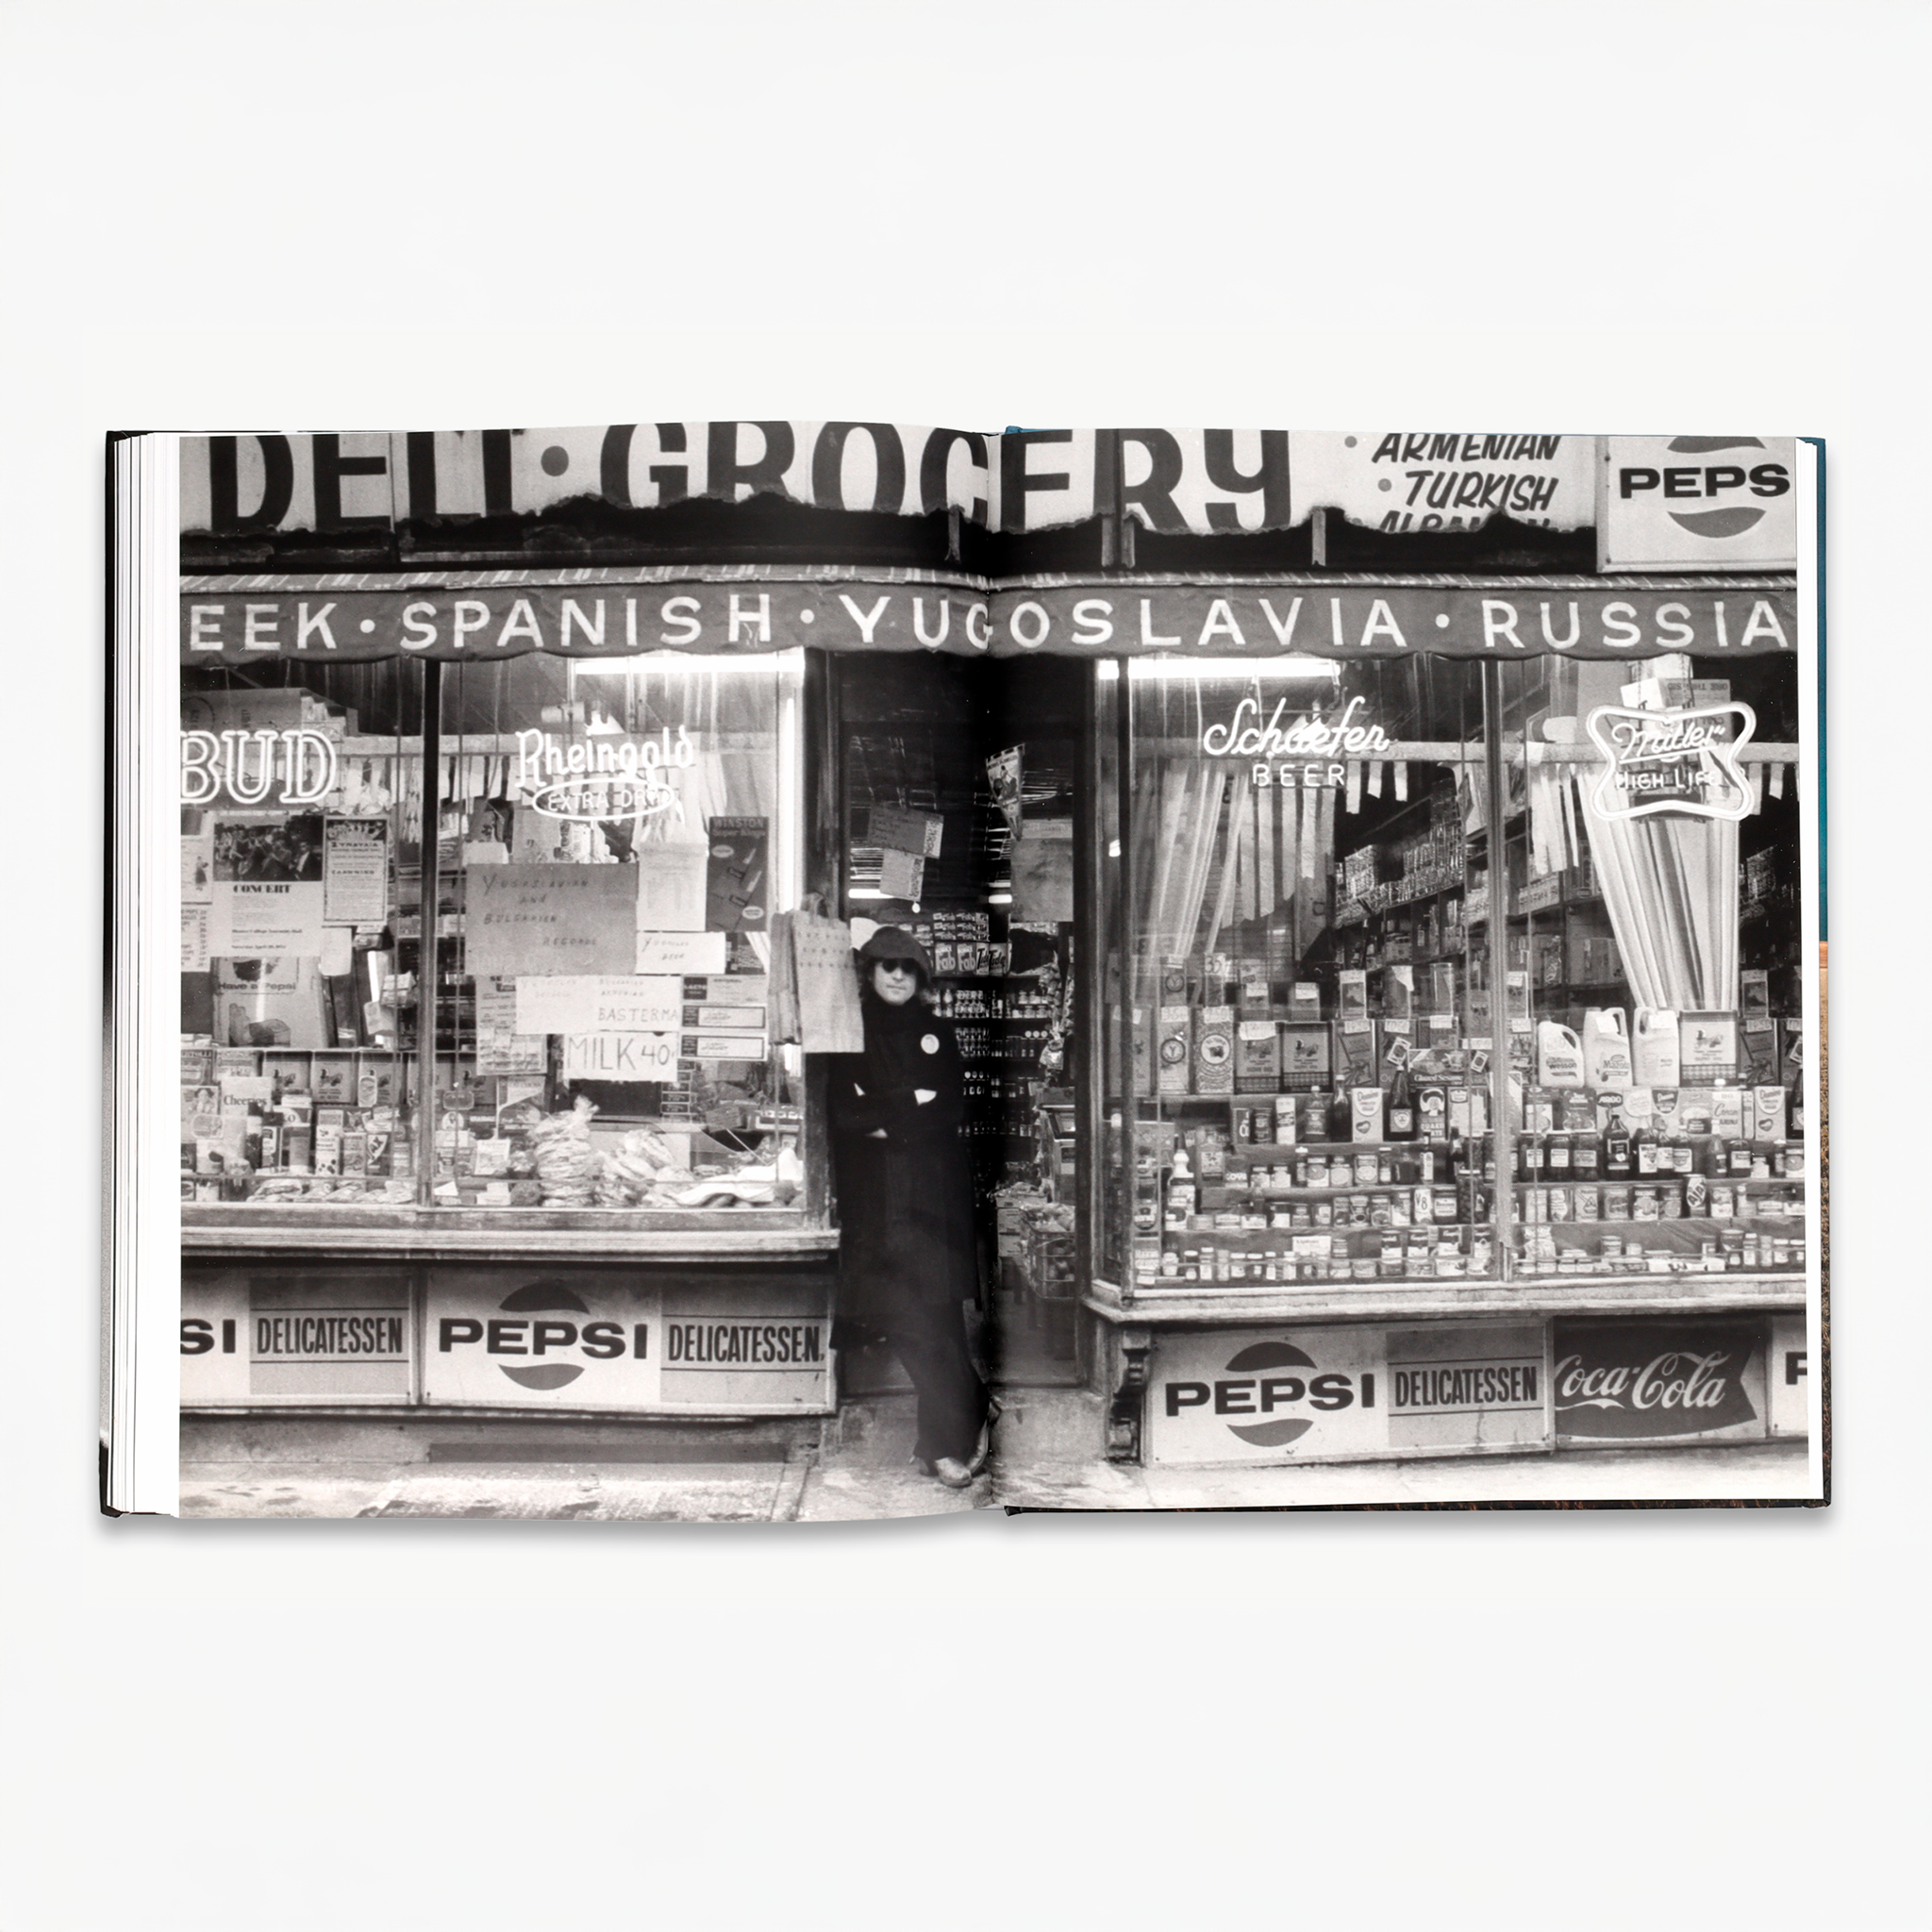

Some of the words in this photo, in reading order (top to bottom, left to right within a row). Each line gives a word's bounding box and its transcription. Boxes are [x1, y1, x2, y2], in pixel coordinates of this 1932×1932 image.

[1372, 433, 1562, 463] ARMENIAN
[208, 431, 513, 532] DELI
[1405, 471, 1559, 511] TURKISH
[1619, 463, 1790, 499] PEPS
[190, 601, 339, 651] EEK
[400, 593, 772, 651] SPANISH
[837, 595, 1407, 650] YUGOSLAVIA
[1481, 599, 1789, 650] RUSSIA
[1203, 695, 1390, 758] Schaefer
[1611, 722, 1722, 760] Miller
[180, 729, 337, 804] BUD
[514, 724, 694, 789] Rheingold
[1252, 763, 1345, 788] BEER
[1615, 770, 1665, 790] HIGH
[1674, 768, 1720, 790] LIFE
[547, 790, 610, 812] EXTRA
[233, 884, 291, 893] CONCERT
[567, 1036, 636, 1071] MILK
[180, 1318, 236, 1356] SI
[257, 1317, 403, 1355] DELICATESSEN
[439, 1317, 648, 1359] PEPSI
[668, 1324, 821, 1363] DELICATESSEN
[1165, 1372, 1375, 1417] PEPSI
[1395, 1365, 1538, 1407] DELICATESSEN
[1554, 1350, 1732, 1411] Coca-Cola
